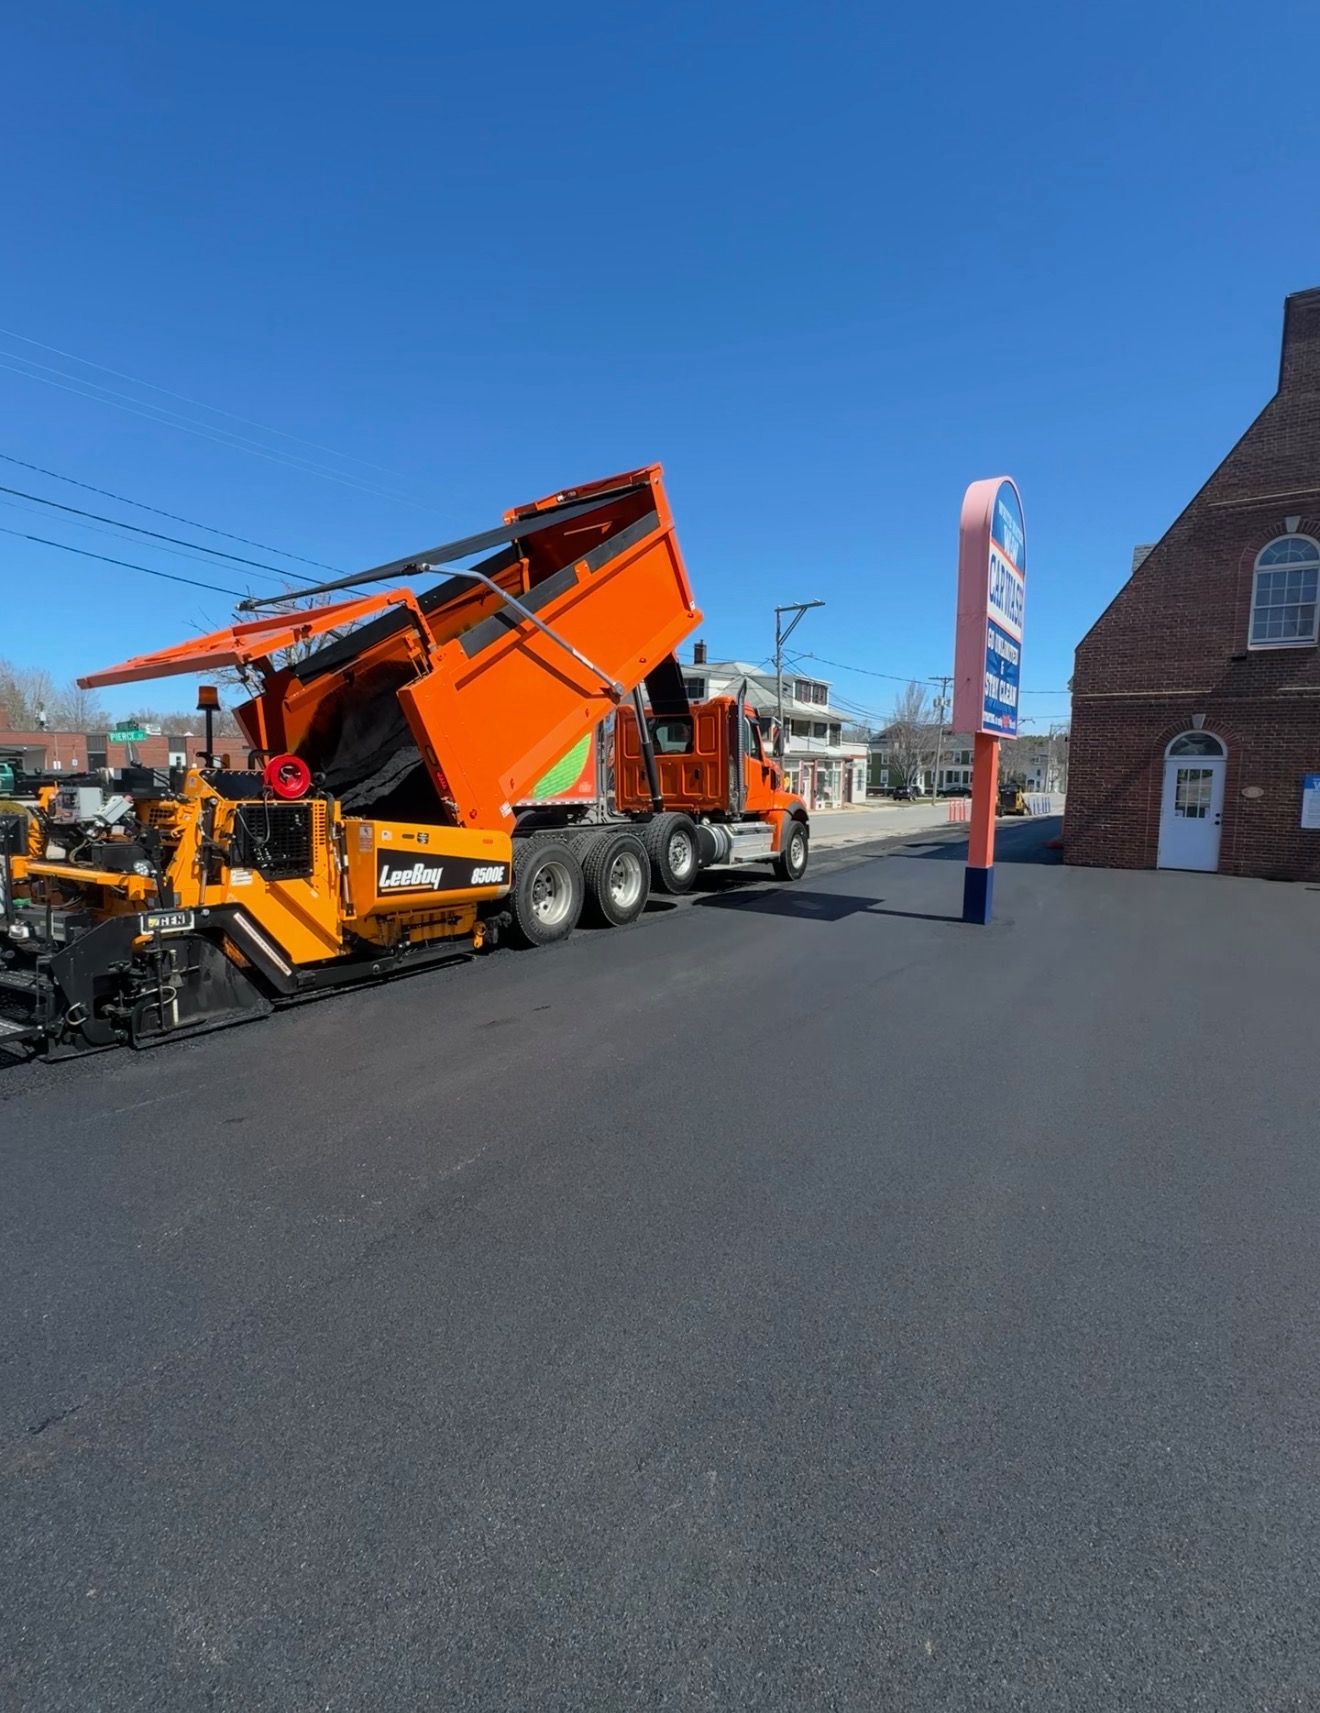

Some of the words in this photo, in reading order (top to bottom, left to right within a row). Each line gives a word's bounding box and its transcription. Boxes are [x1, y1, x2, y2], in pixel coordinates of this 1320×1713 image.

[990, 554, 1005, 611] CAR
[111, 731, 135, 741] PIERCE
[379, 863, 443, 890] LeeBoy
[471, 866, 505, 885] 8500E
